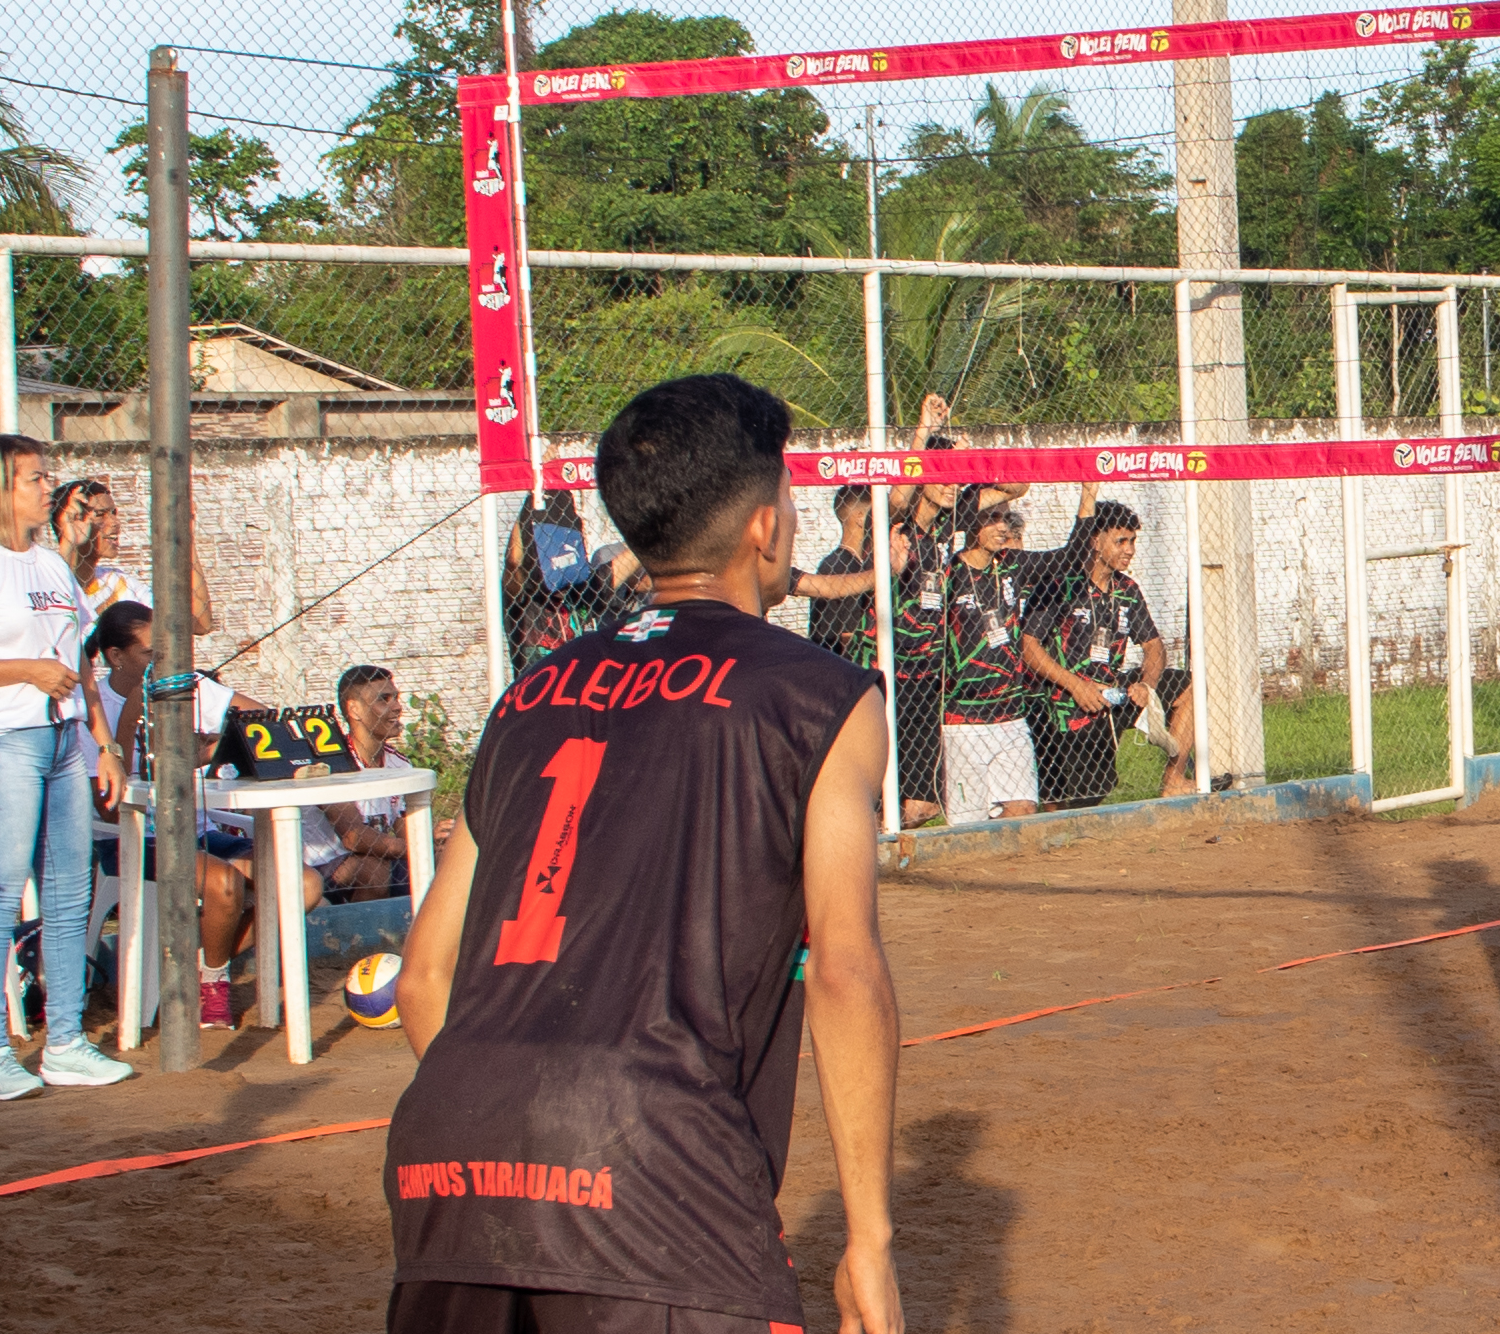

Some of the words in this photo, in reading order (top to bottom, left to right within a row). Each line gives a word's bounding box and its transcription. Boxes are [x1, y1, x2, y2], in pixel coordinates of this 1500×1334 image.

[1412, 10, 1449, 32] SENA
[1149, 451, 1185, 472] SENA
[1453, 443, 1489, 464] SENA
[867, 457, 901, 477] SENA
[245, 723, 282, 760] 2
[305, 717, 342, 753] 2
[493, 737, 608, 966] 1
[397, 1161, 466, 1200] CAMPUS
[467, 1161, 613, 1210] TARAUACÁ
